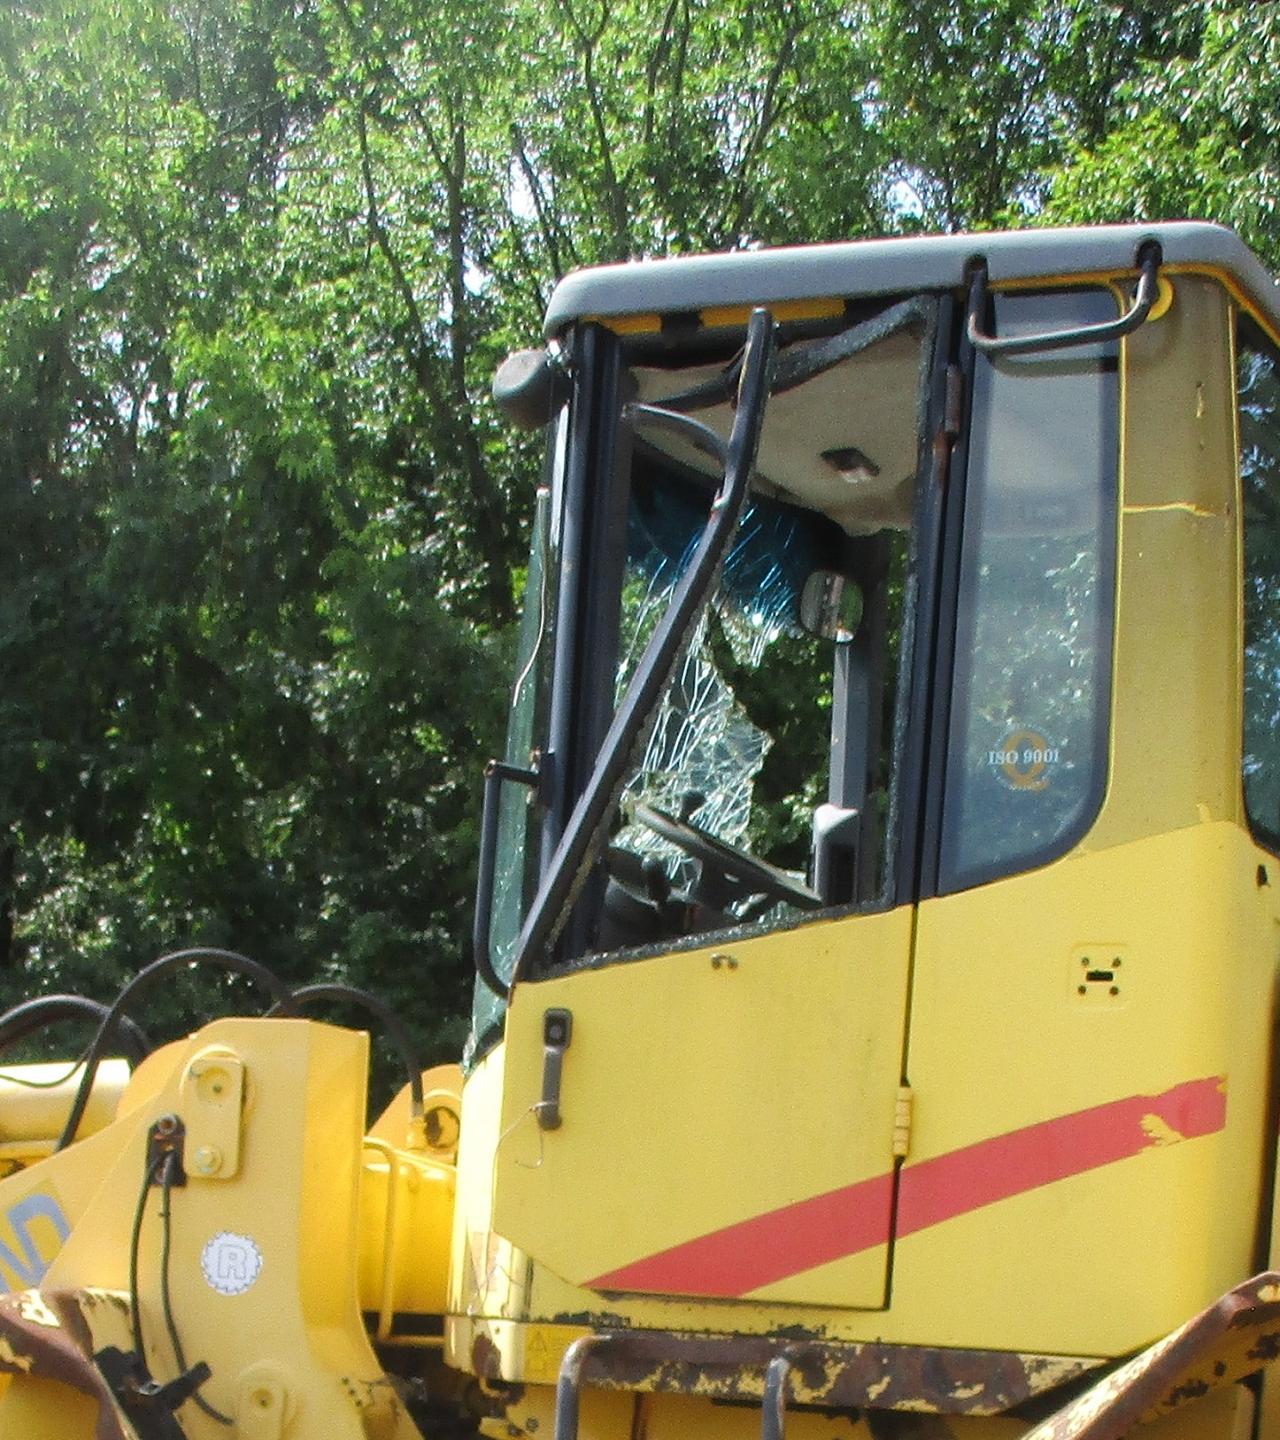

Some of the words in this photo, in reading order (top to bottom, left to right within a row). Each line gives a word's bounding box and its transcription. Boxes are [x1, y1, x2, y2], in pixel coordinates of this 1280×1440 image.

[988, 751, 1018, 765] ISO
[1023, 748, 1059, 763] 9001
[217, 1243, 247, 1280] R
